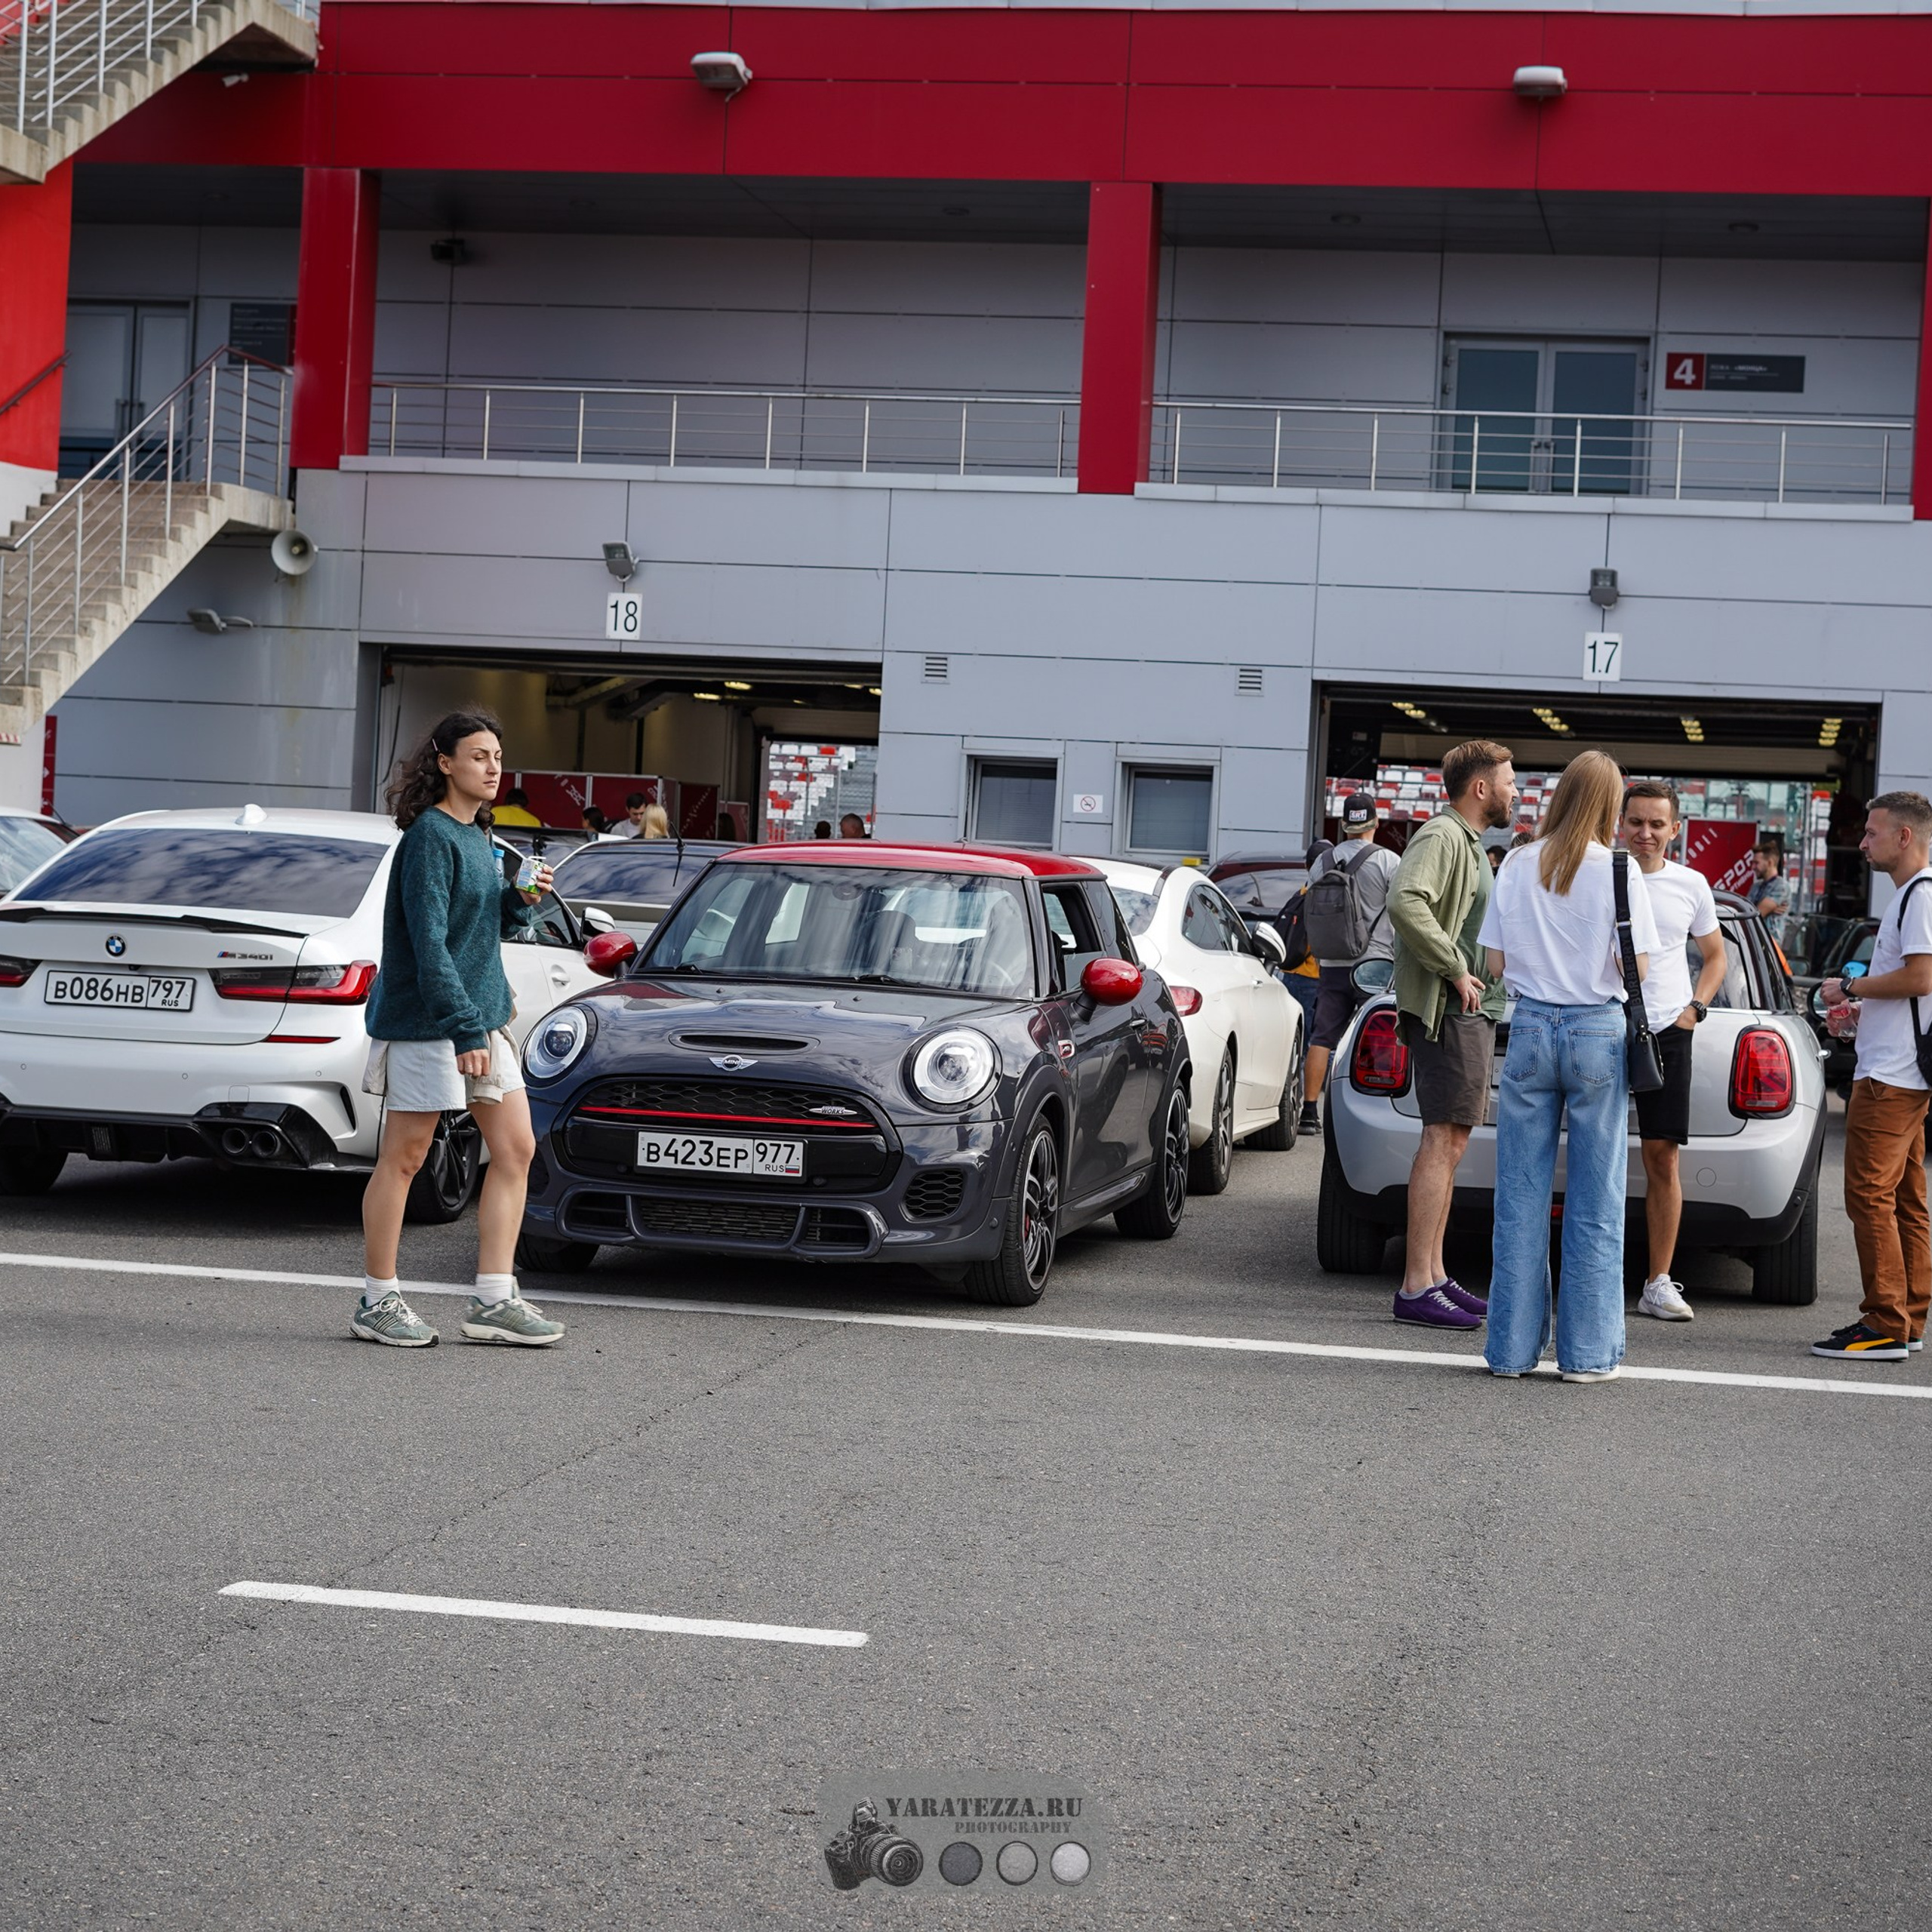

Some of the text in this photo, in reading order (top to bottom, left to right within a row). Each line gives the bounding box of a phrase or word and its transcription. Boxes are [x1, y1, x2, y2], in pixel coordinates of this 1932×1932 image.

[1673, 358, 1696, 385] 4
[611, 600, 638, 632] 18
[1622, 938, 1641, 1006] BURBERRY
[151, 980, 186, 999] 797
[162, 998, 179, 1007] RUS
[755, 1143, 795, 1164] 977
[764, 1164, 785, 1173] RUS
